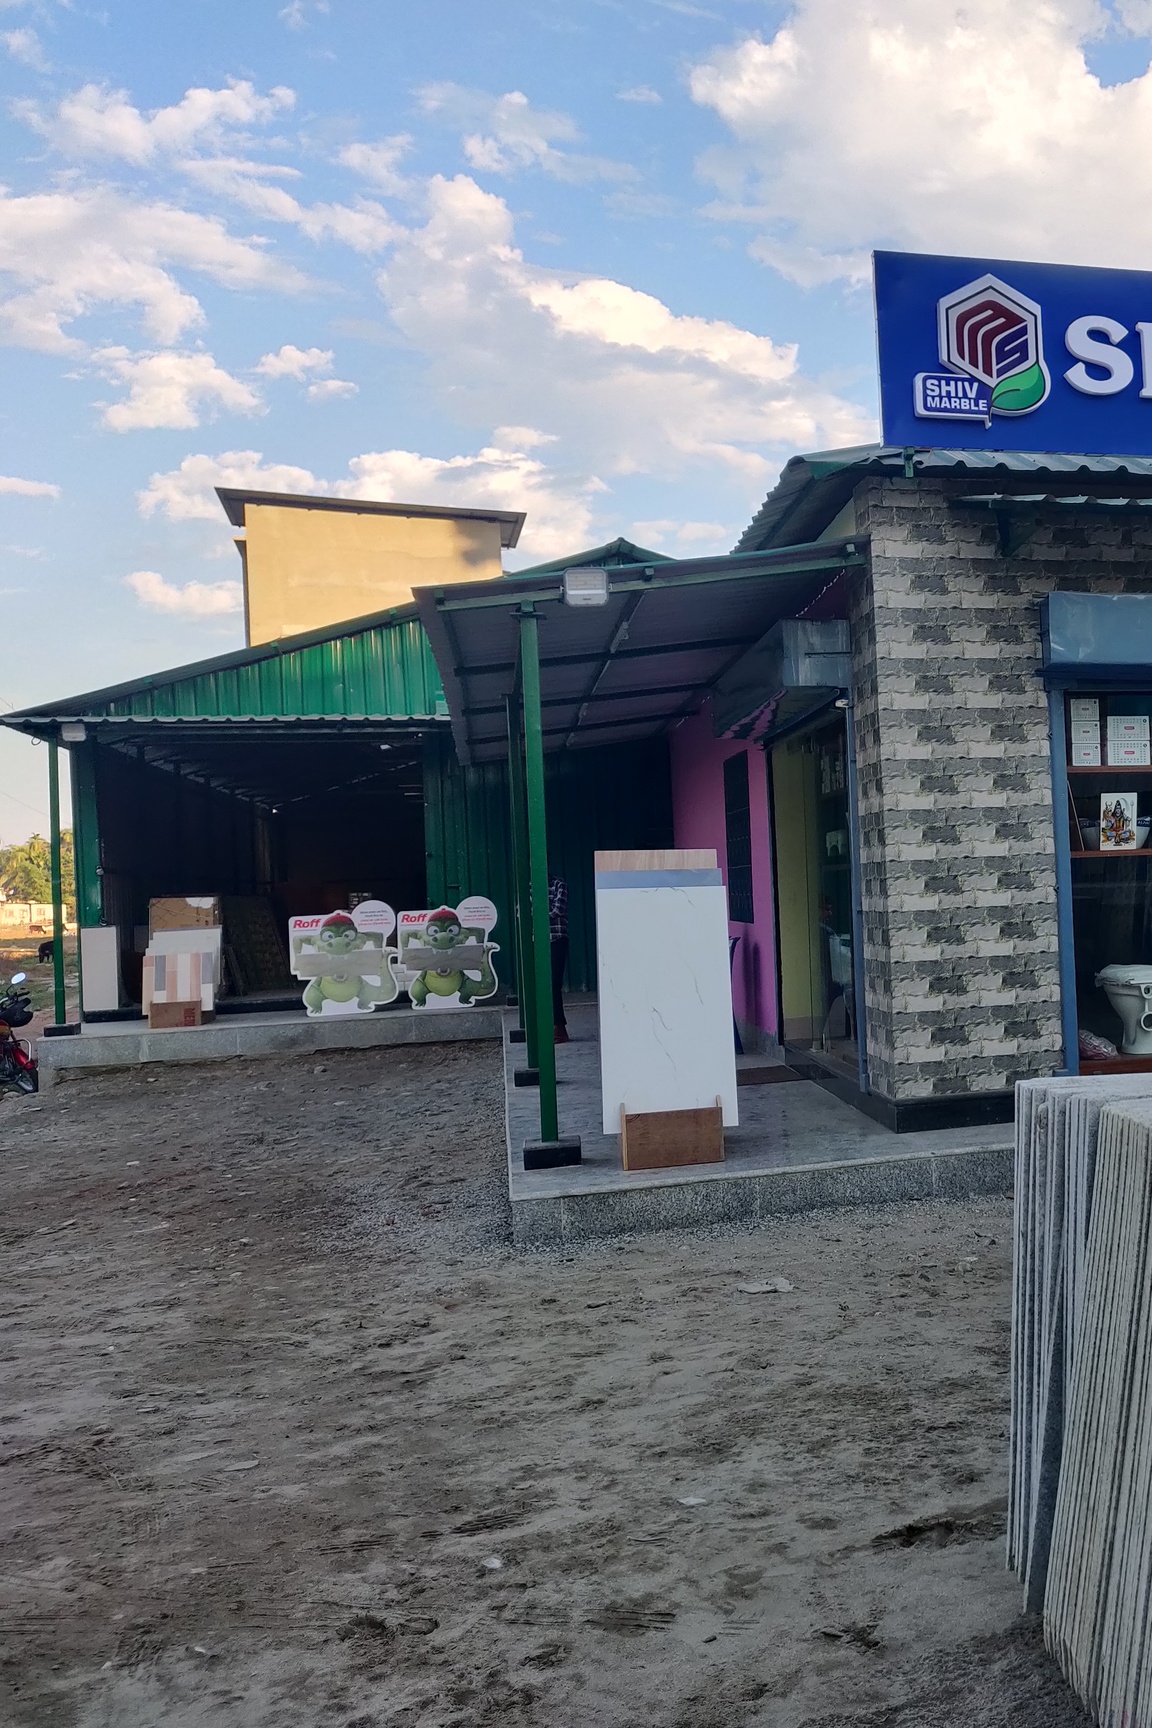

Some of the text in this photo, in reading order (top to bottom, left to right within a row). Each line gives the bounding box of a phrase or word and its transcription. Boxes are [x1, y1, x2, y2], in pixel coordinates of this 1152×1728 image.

[925, 378, 979, 399] SHIV
[926, 396, 988, 411] MARBLE
[293, 918, 321, 929] Roff
[401, 913, 428, 923] Roff
